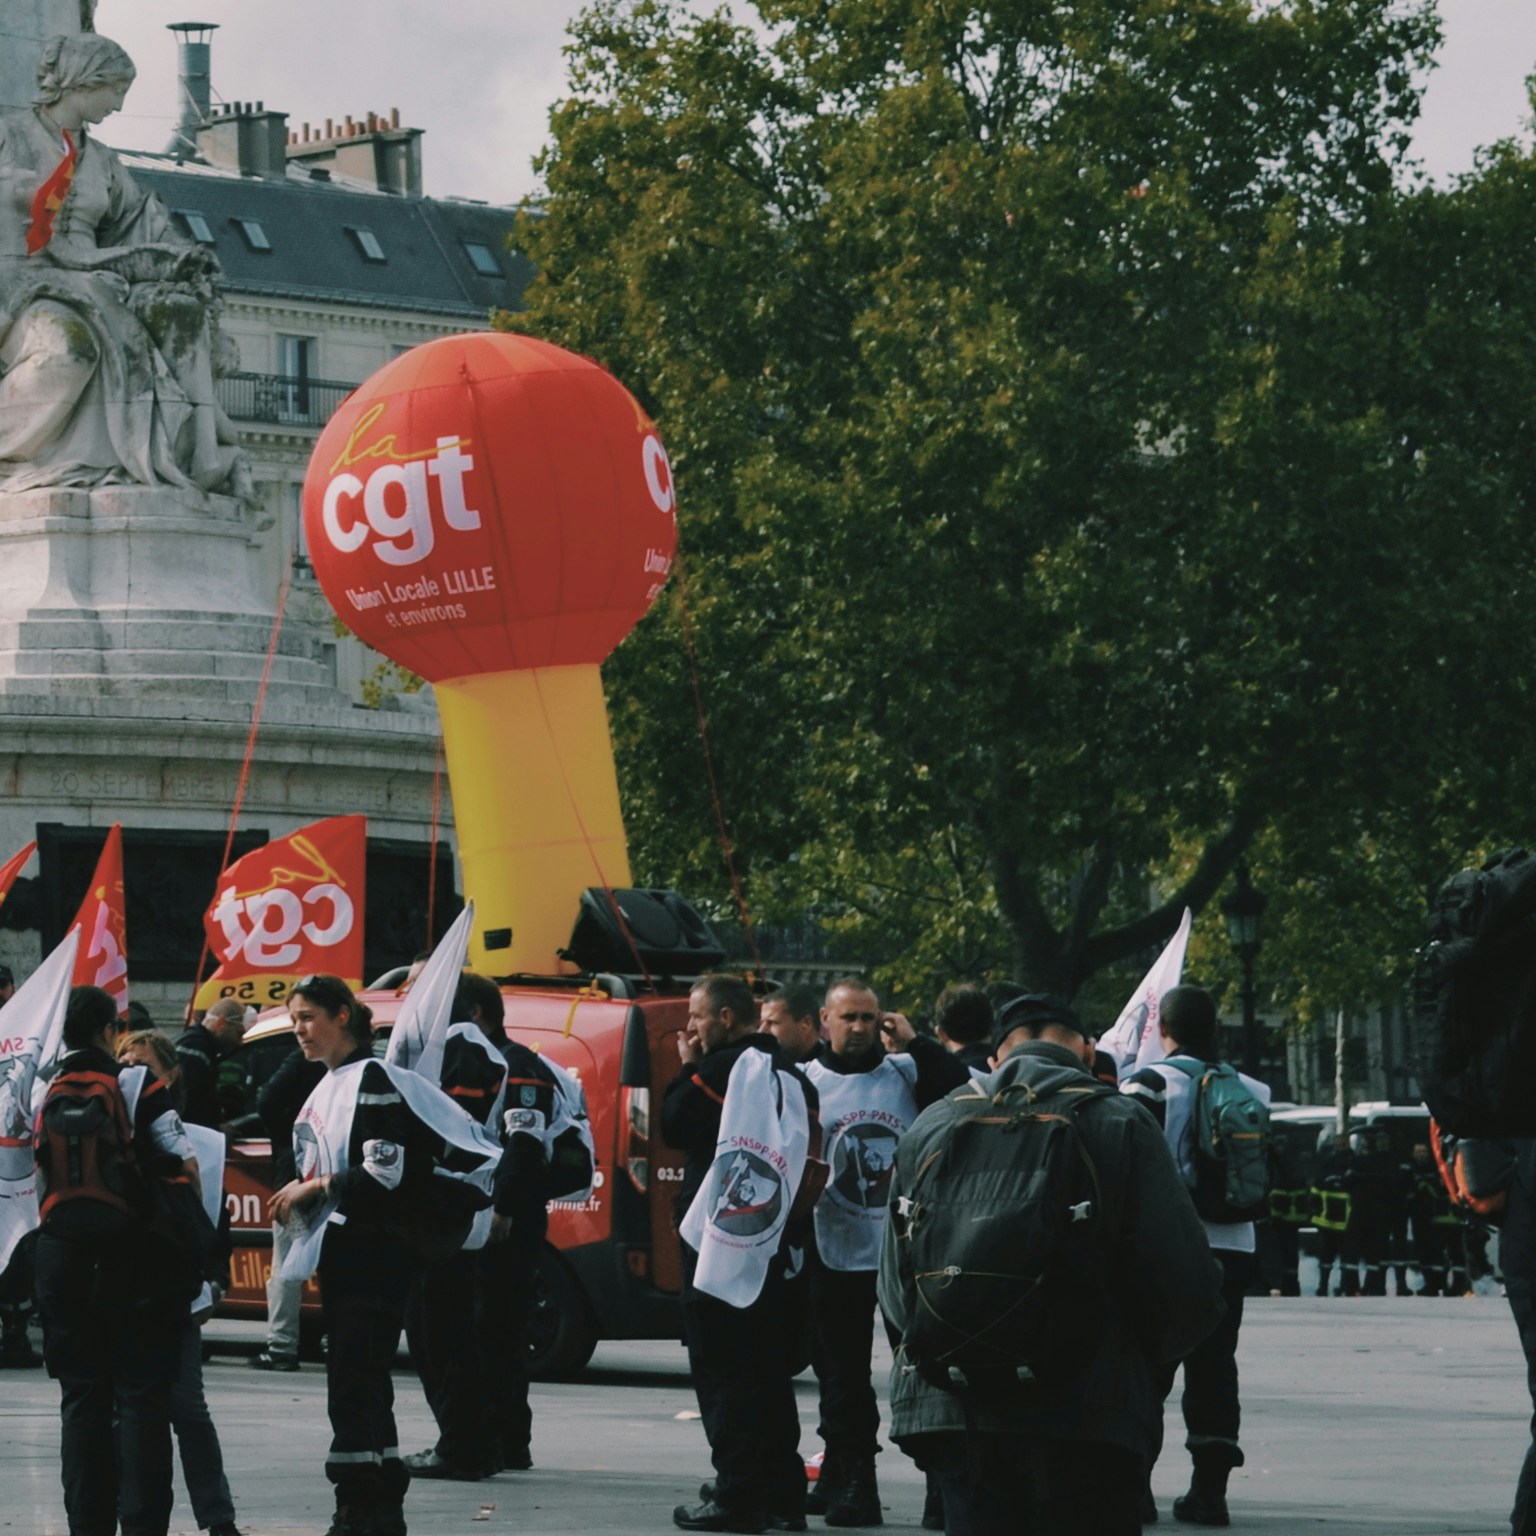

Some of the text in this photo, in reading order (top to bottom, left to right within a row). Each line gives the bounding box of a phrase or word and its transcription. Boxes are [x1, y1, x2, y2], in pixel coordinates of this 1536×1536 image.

[323, 435, 481, 566] cgt
[345, 566, 496, 611] Union Locale LILLE
[385, 602, 466, 628] et environs
[49, 771, 78, 794] 20
